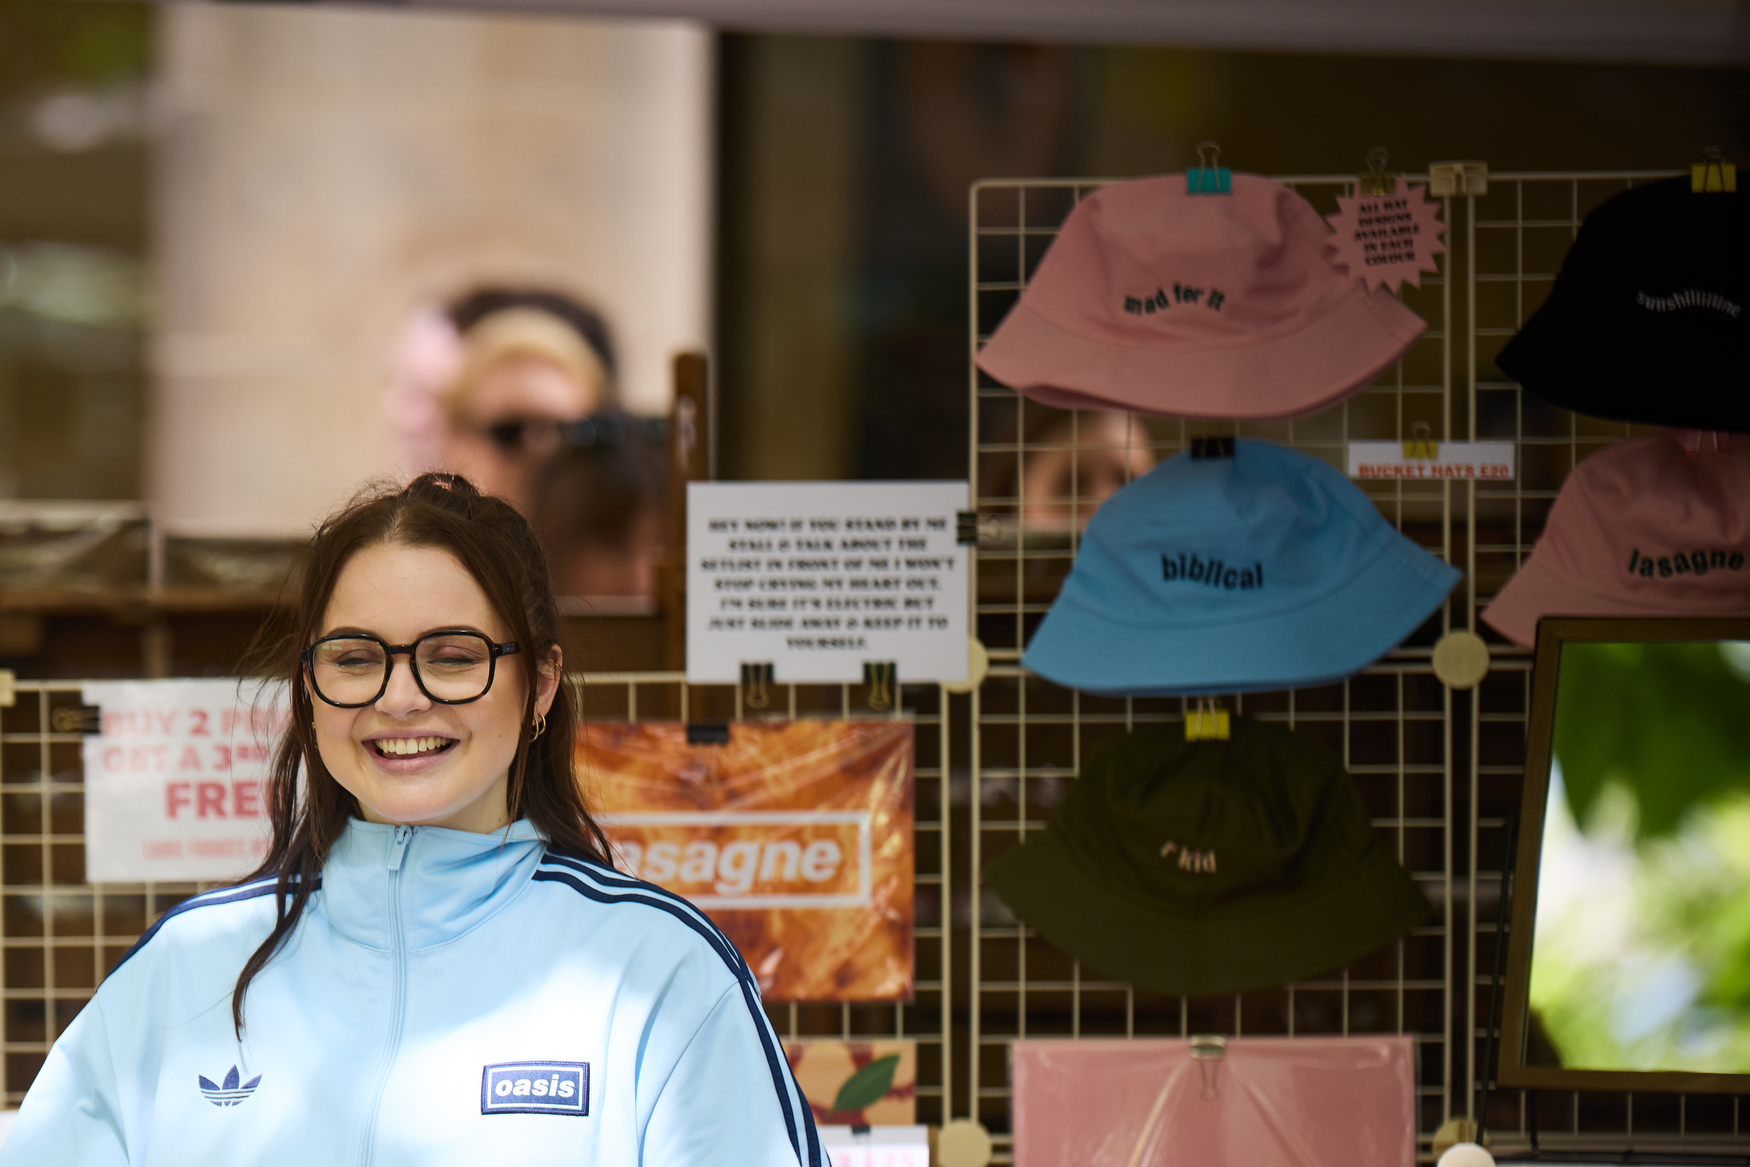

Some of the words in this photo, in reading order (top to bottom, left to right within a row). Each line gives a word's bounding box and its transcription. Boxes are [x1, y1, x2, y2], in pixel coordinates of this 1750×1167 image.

[1360, 203, 1379, 213] ALL
[1383, 200, 1408, 211] HAT
[1359, 213, 1412, 228] DESIGNS
[1354, 224, 1420, 241] AVAILABLE
[1364, 242, 1378, 253] IN
[1380, 239, 1413, 251] EACH
[1365, 251, 1415, 266] COLOUR
[1124, 285, 1169, 316] mad
[1207, 287, 1226, 313] it
[1358, 463, 1426, 478] BUCKET
[1431, 463, 1475, 478] HATS
[1480, 463, 1509, 478] £20
[708, 518, 738, 533] HEY
[809, 518, 841, 533] YOU
[845, 518, 897, 533] STAND
[901, 518, 920, 533] BY
[728, 537, 772, 551] STALL
[796, 537, 834, 551] TALK
[840, 537, 892, 551] ABOUT
[898, 537, 927, 551] THE
[700, 557, 762, 572] SETLIST
[767, 557, 783, 572] IN
[788, 557, 839, 572] FRONT
[844, 557, 863, 572] OF
[905, 557, 955, 572] WON'T
[1629, 547, 1745, 578] lasagne
[1161, 553, 1264, 591] biblical
[714, 577, 754, 592] STOP
[759, 577, 817, 592] CRYING
[822, 577, 844, 592] MY
[849, 577, 901, 592] HEART
[748, 597, 787, 612] SURE
[826, 597, 899, 612] ELECTRIC
[904, 597, 934, 612] BUT
[707, 617, 745, 632] JUST
[750, 617, 793, 632] SLIDE
[800, 617, 842, 632] AWAY
[863, 617, 902, 632] KEEP
[928, 617, 948, 632] TO
[101, 708, 178, 736] BUY
[188, 708, 211, 736] 2
[101, 743, 169, 772] GET
[178, 743, 202, 772] A
[605, 838, 841, 895] asagne
[1178, 844, 1217, 874] kid
[495, 1074, 575, 1098] oasis
